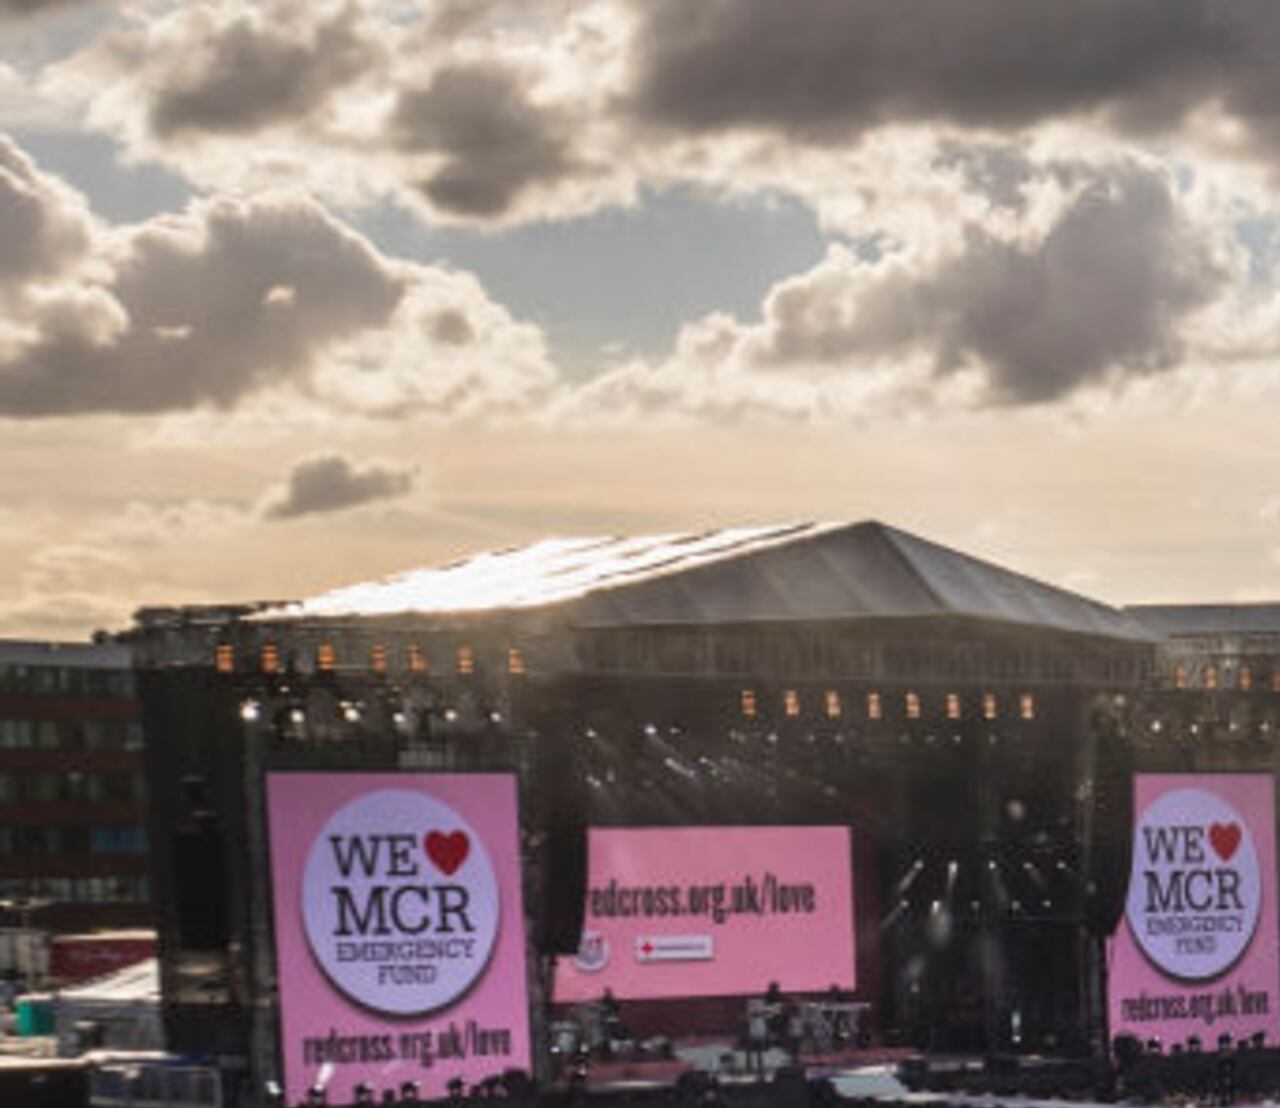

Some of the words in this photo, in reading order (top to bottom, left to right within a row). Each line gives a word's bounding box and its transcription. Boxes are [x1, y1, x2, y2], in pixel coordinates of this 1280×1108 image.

[329, 834, 420, 879] WE
[1142, 825, 1206, 865] WE
[329, 884, 478, 937] MCR
[1143, 868, 1245, 914] MCR
[1145, 914, 1244, 937] EMERGENCY
[1174, 936, 1217, 955] FUND
[336, 937, 478, 964] EMERGENCY
[377, 963, 439, 986] FUND
[302, 1019, 512, 1068] redcross.org.uk/love
